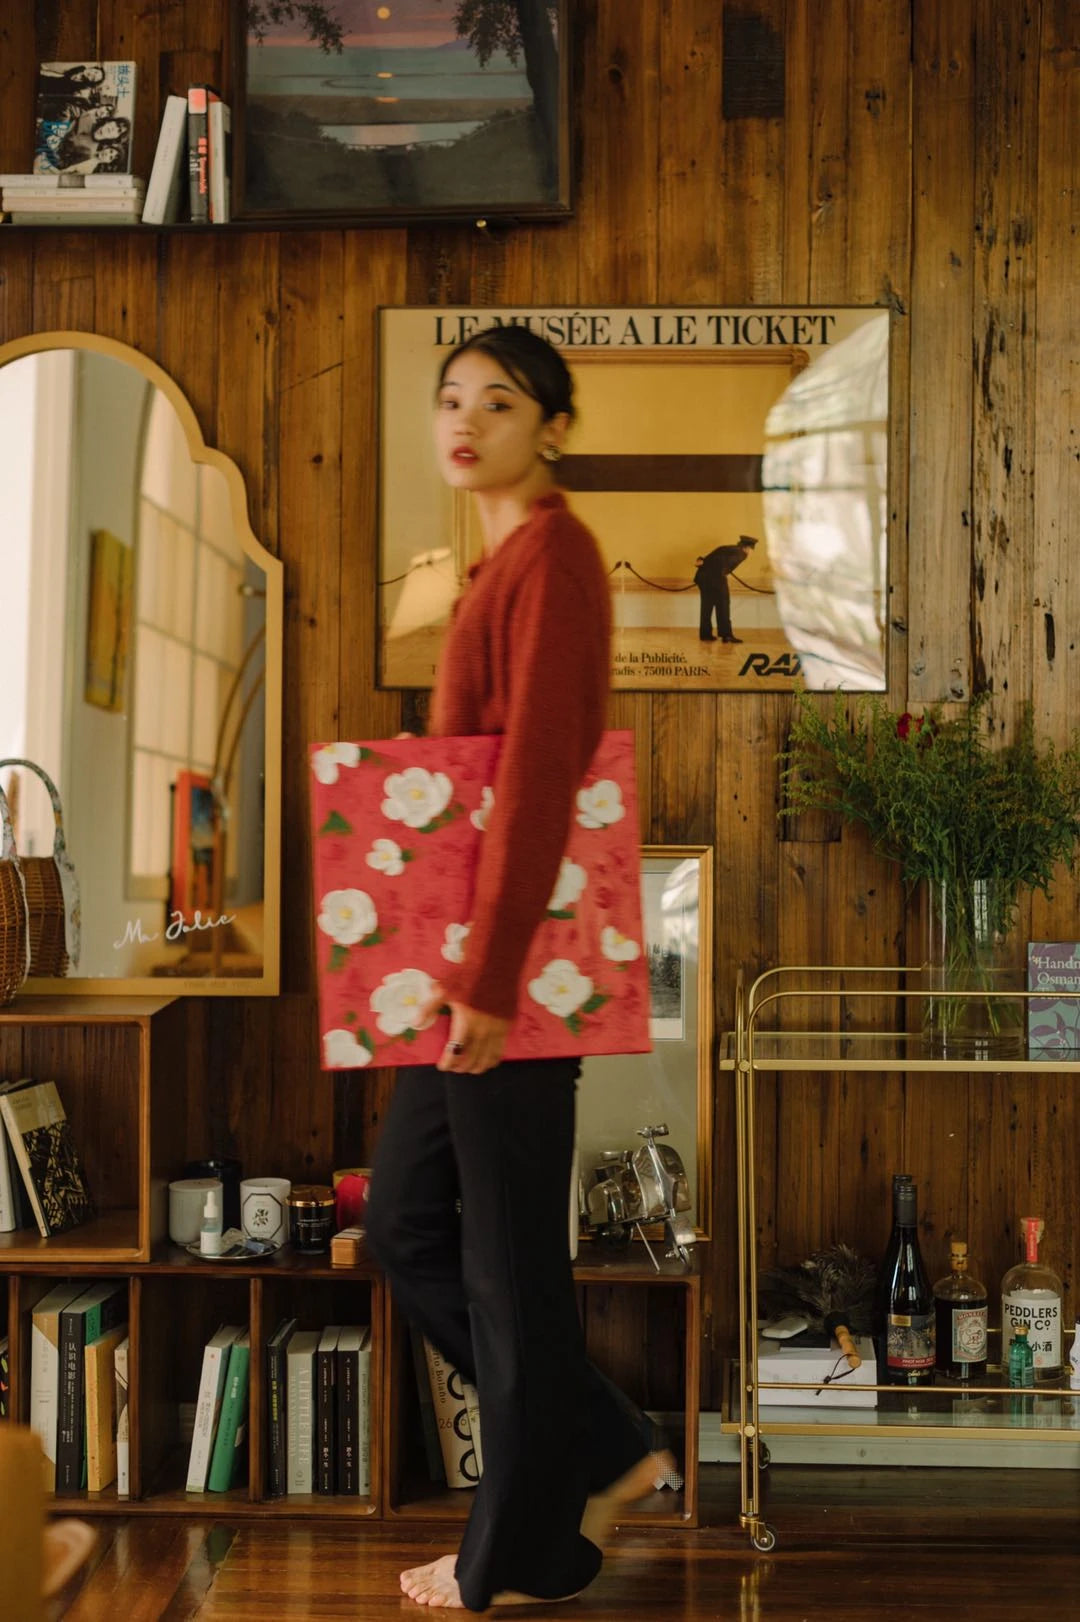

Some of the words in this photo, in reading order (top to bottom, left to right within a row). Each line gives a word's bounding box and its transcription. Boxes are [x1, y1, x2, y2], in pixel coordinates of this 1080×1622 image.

[618, 315, 644, 345] A
[651, 315, 697, 345] LE
[707, 314, 836, 346] TICKET
[629, 653, 639, 664] la
[641, 652, 688, 664] Publicité.
[643, 666, 672, 677] 75010
[674, 665, 711, 677] PARIS.
[1004, 1304, 1058, 1319] PEDDLERS
[1010, 1317, 1031, 1330] GIN
[68, 1342, 77, 1380] 认识电影
